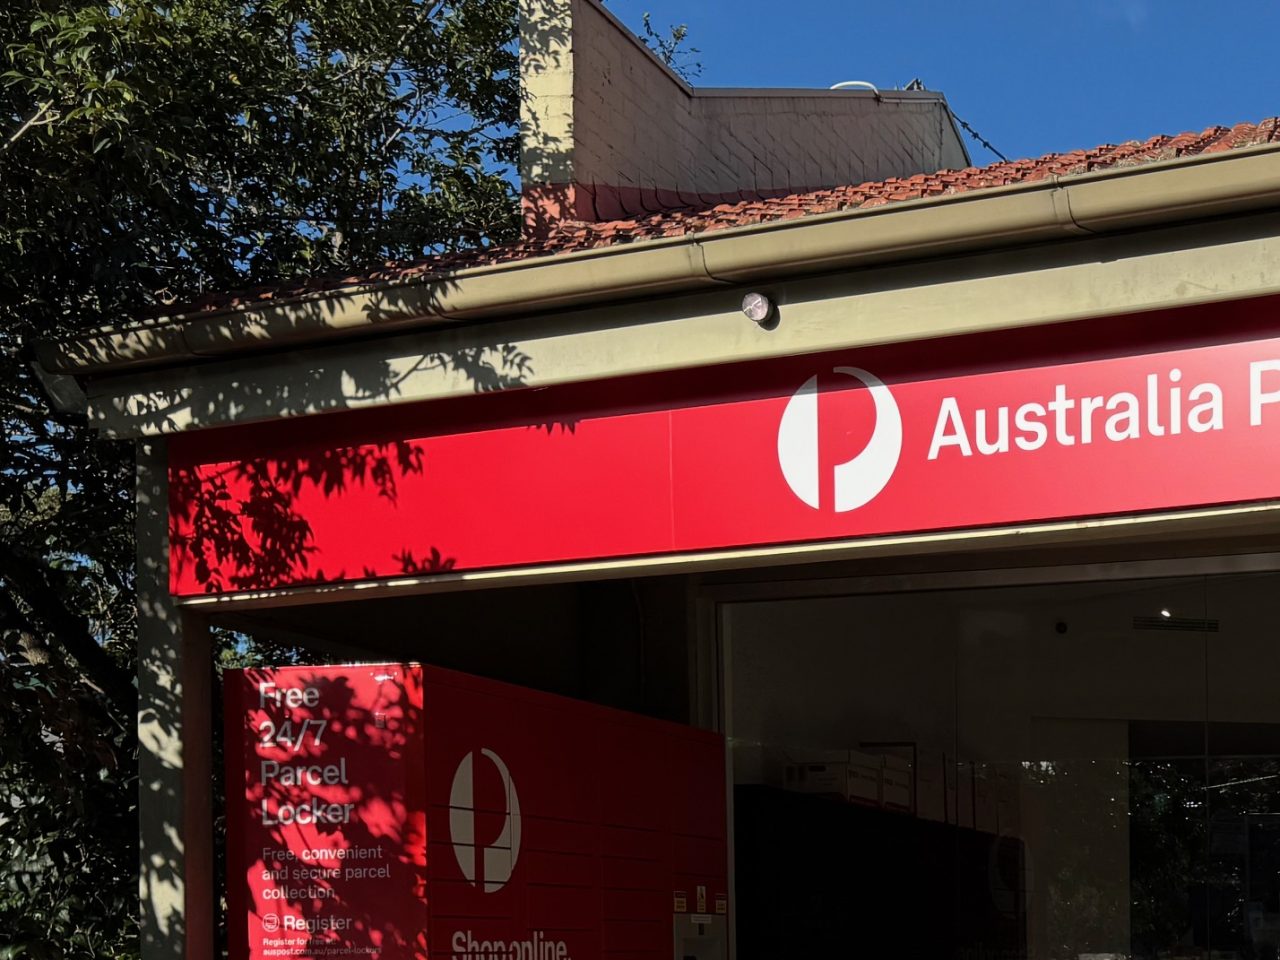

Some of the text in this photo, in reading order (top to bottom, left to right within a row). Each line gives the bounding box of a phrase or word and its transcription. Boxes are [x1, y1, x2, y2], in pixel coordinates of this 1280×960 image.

[927, 368, 1224, 461] Australia
[259, 682, 319, 709] Free
[259, 719, 327, 751] 24/7
[260, 757, 348, 786] Parcel
[261, 797, 354, 826] Locker
[262, 845, 382, 862] Free, convenient
[262, 864, 391, 881] and secure parcel
[262, 884, 336, 899] collection
[283, 914, 352, 933] Register
[263, 938, 295, 947] Register
